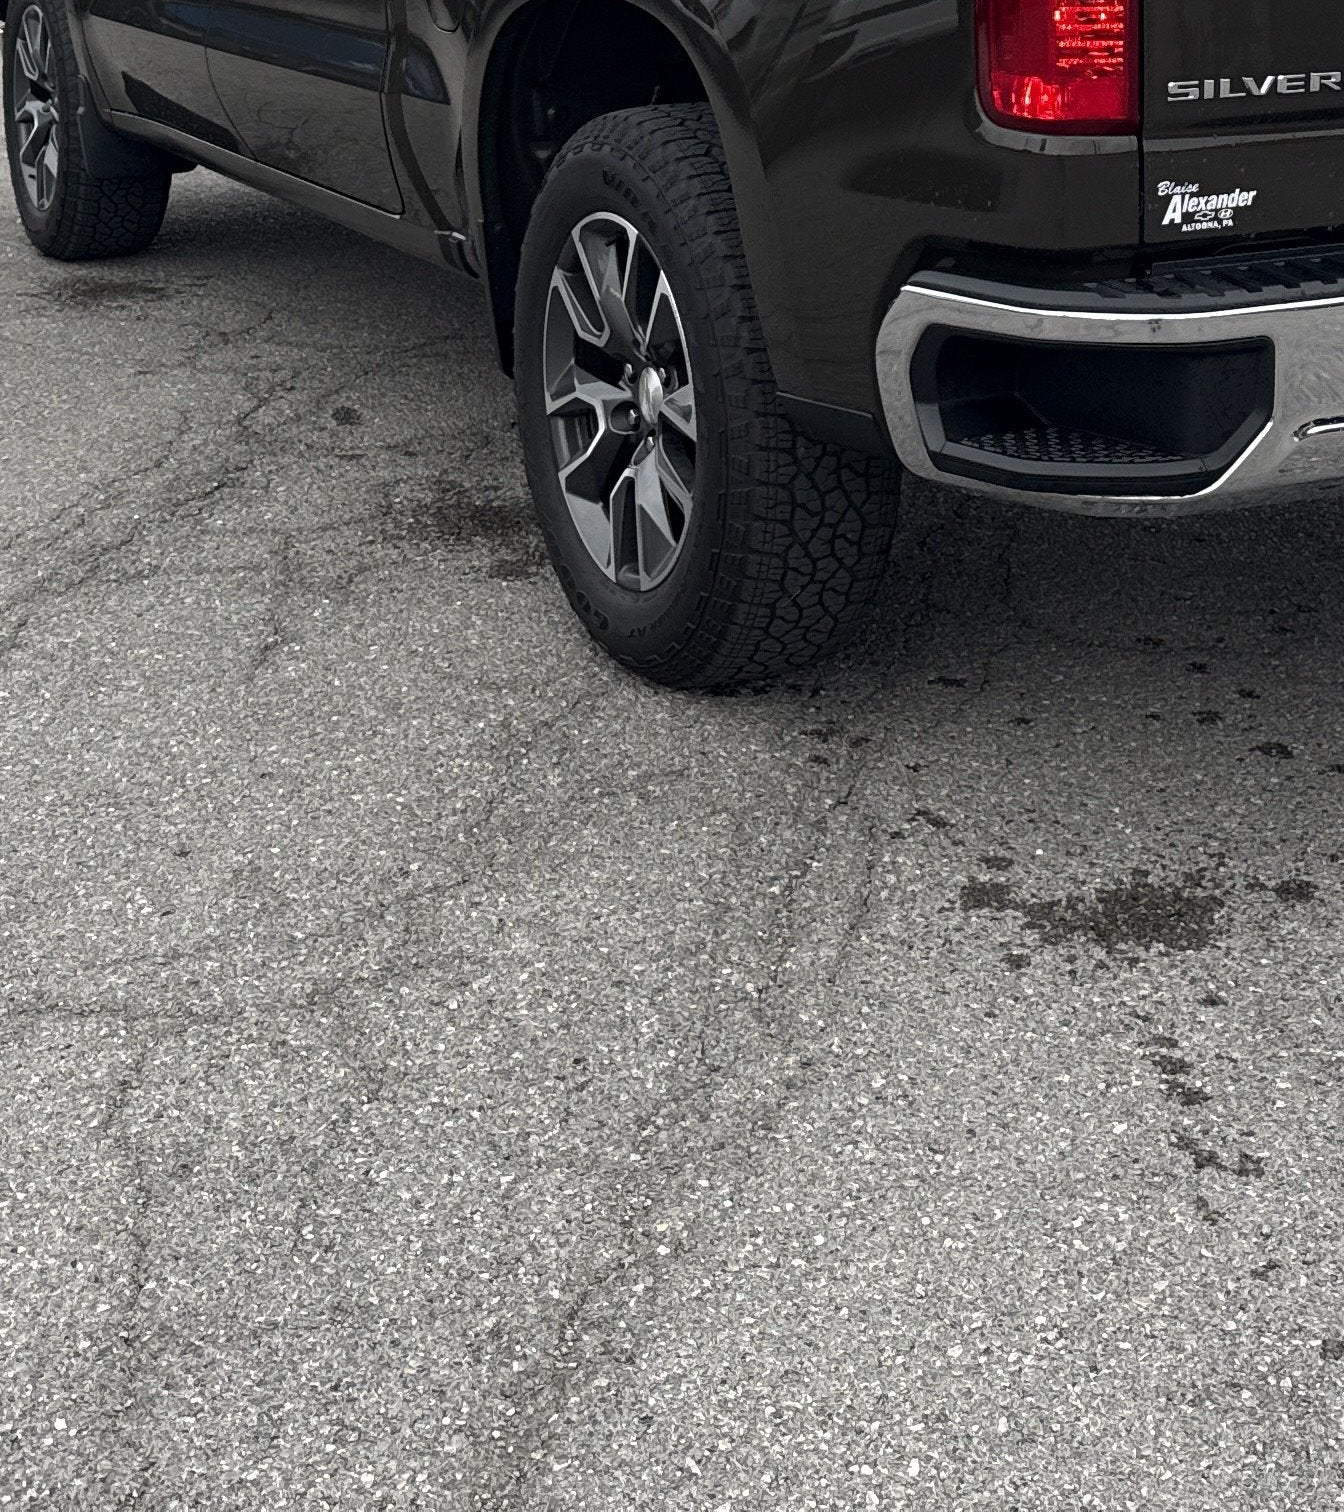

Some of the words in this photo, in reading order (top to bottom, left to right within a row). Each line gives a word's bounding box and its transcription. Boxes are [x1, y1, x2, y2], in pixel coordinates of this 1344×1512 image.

[1157, 181, 1199, 196] Blaise
[1161, 188, 1257, 225] Alexander
[1222, 218, 1234, 228] PA
